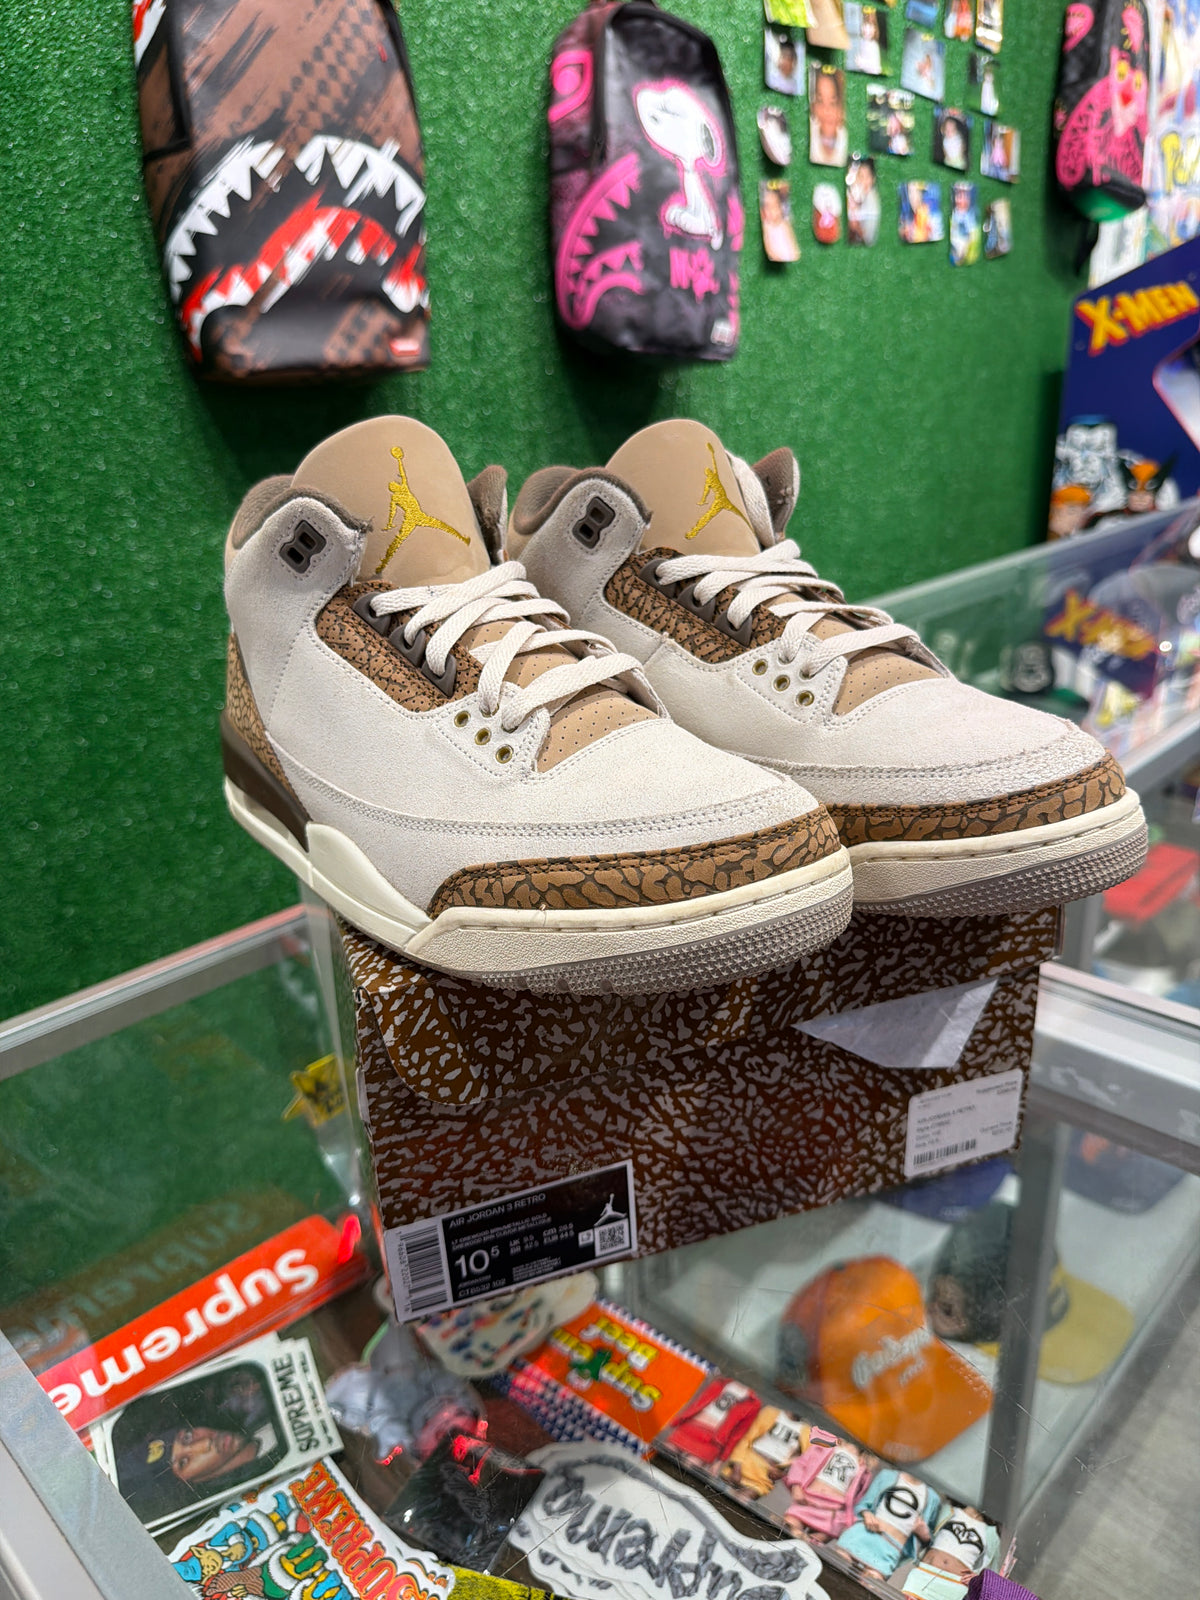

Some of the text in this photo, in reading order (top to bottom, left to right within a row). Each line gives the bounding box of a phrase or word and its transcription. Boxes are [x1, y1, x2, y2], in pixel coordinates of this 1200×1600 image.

[1075, 280, 1199, 356] X-MEN
[449, 1192, 546, 1228] AIR JORDAN 3 RETRO
[48, 1249, 319, 1416] Supreme
[579, 1317, 660, 1371] Beef
[271, 1352, 320, 1452] SUPREME
